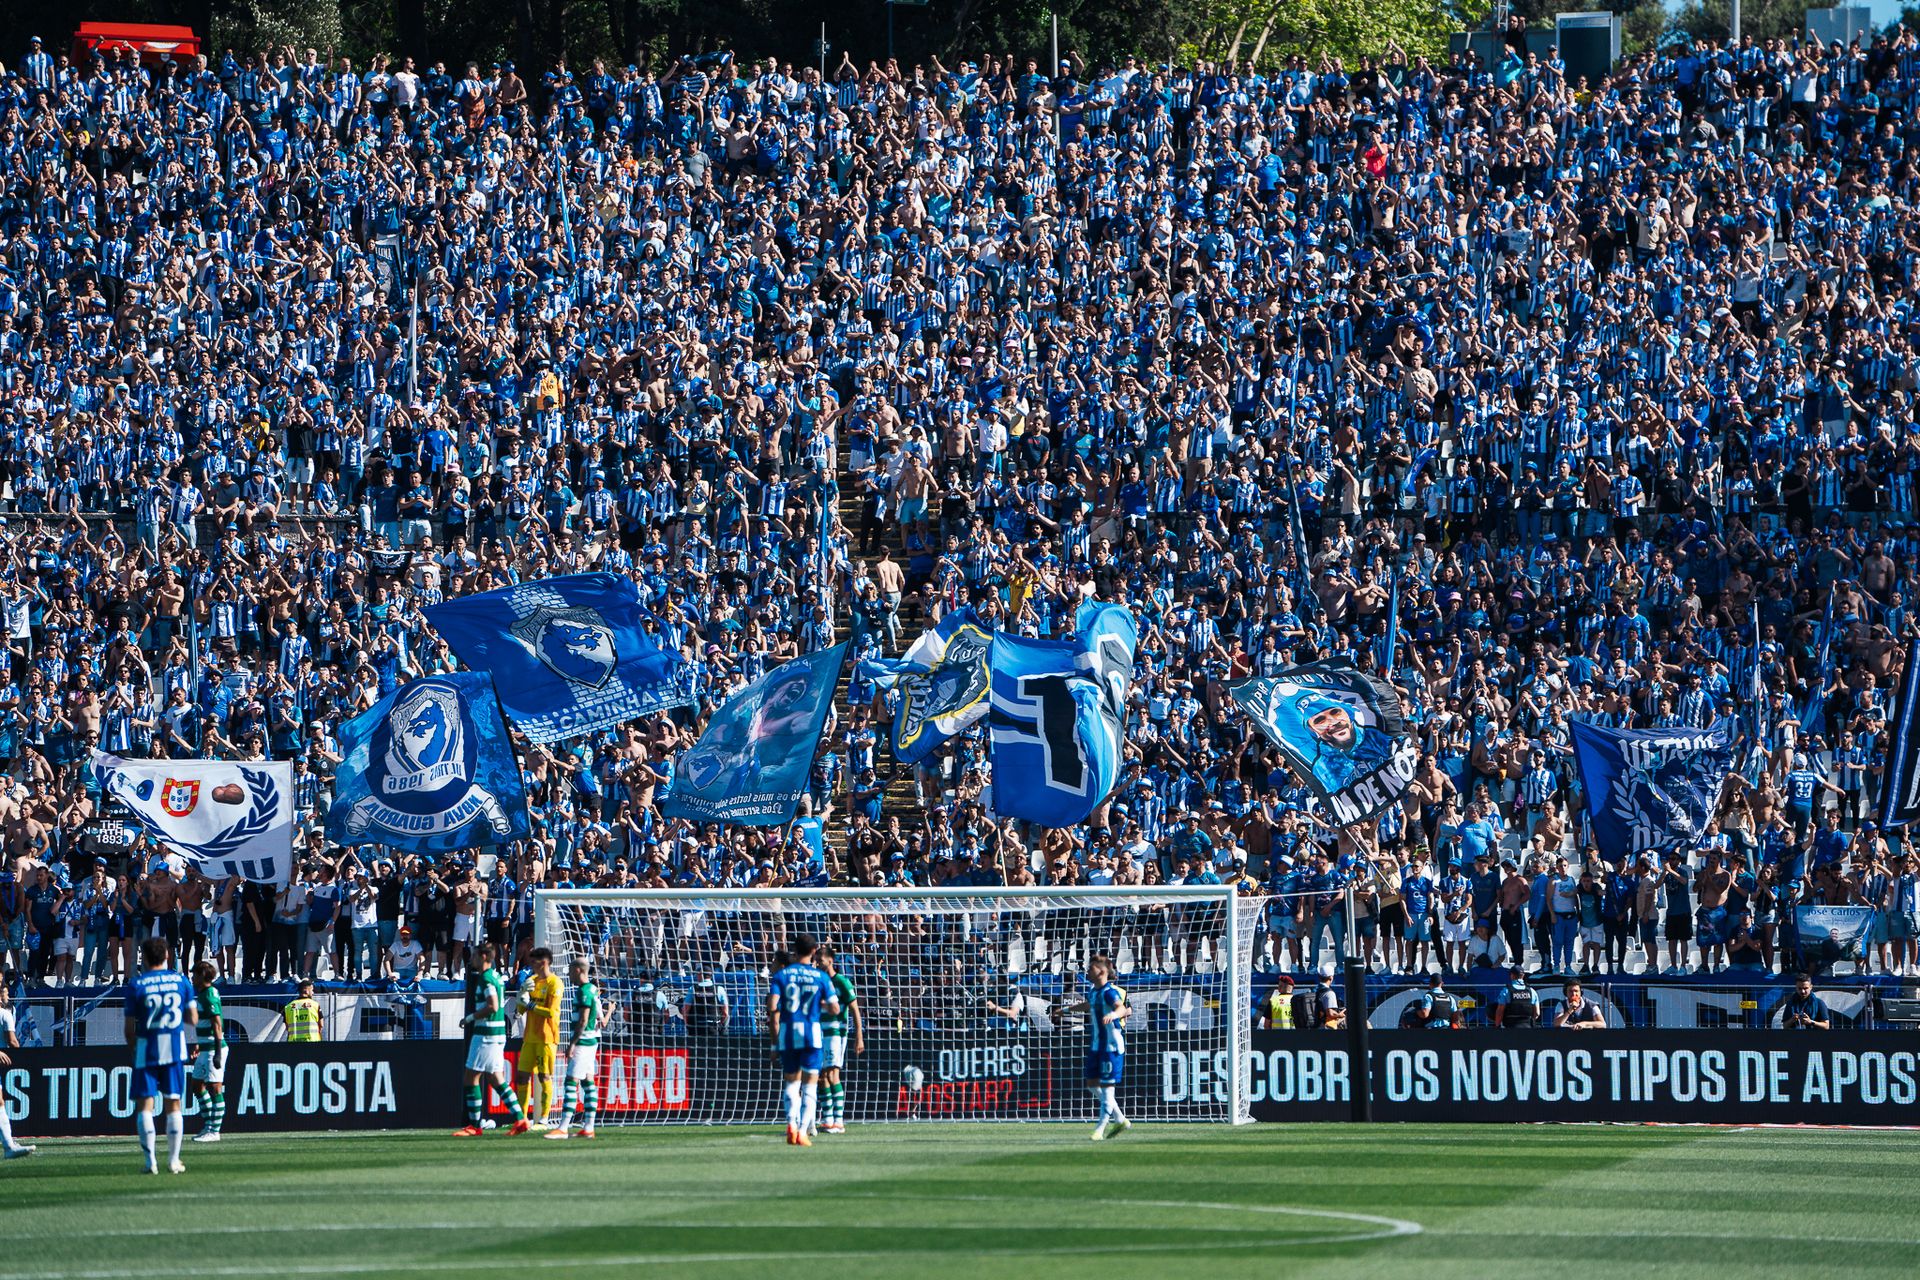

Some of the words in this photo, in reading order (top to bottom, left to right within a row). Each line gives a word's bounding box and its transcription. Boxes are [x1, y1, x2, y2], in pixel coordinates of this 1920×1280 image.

[560, 691, 657, 729] CAMINHA
[1354, 776, 1387, 814] DE
[96, 834, 123, 845] 1893
[100, 820, 123, 829] THE
[1831, 908, 1861, 916] Carlos
[146, 992, 182, 1029] 23
[785, 982, 819, 1015] 97
[939, 1044, 1026, 1082] QUERES
[1162, 1050, 1374, 1102] DESCOBR
[1386, 1050, 1440, 1101] OS
[1452, 1050, 1593, 1101] NOVOS
[1603, 1050, 1727, 1102] TIPOS
[1739, 1051, 1790, 1102] DE
[1802, 1052, 1920, 1105] APOS
[42, 1066, 164, 1118] TIPO
[182, 1065, 226, 1117] D
[237, 1062, 397, 1115] APOSTA
